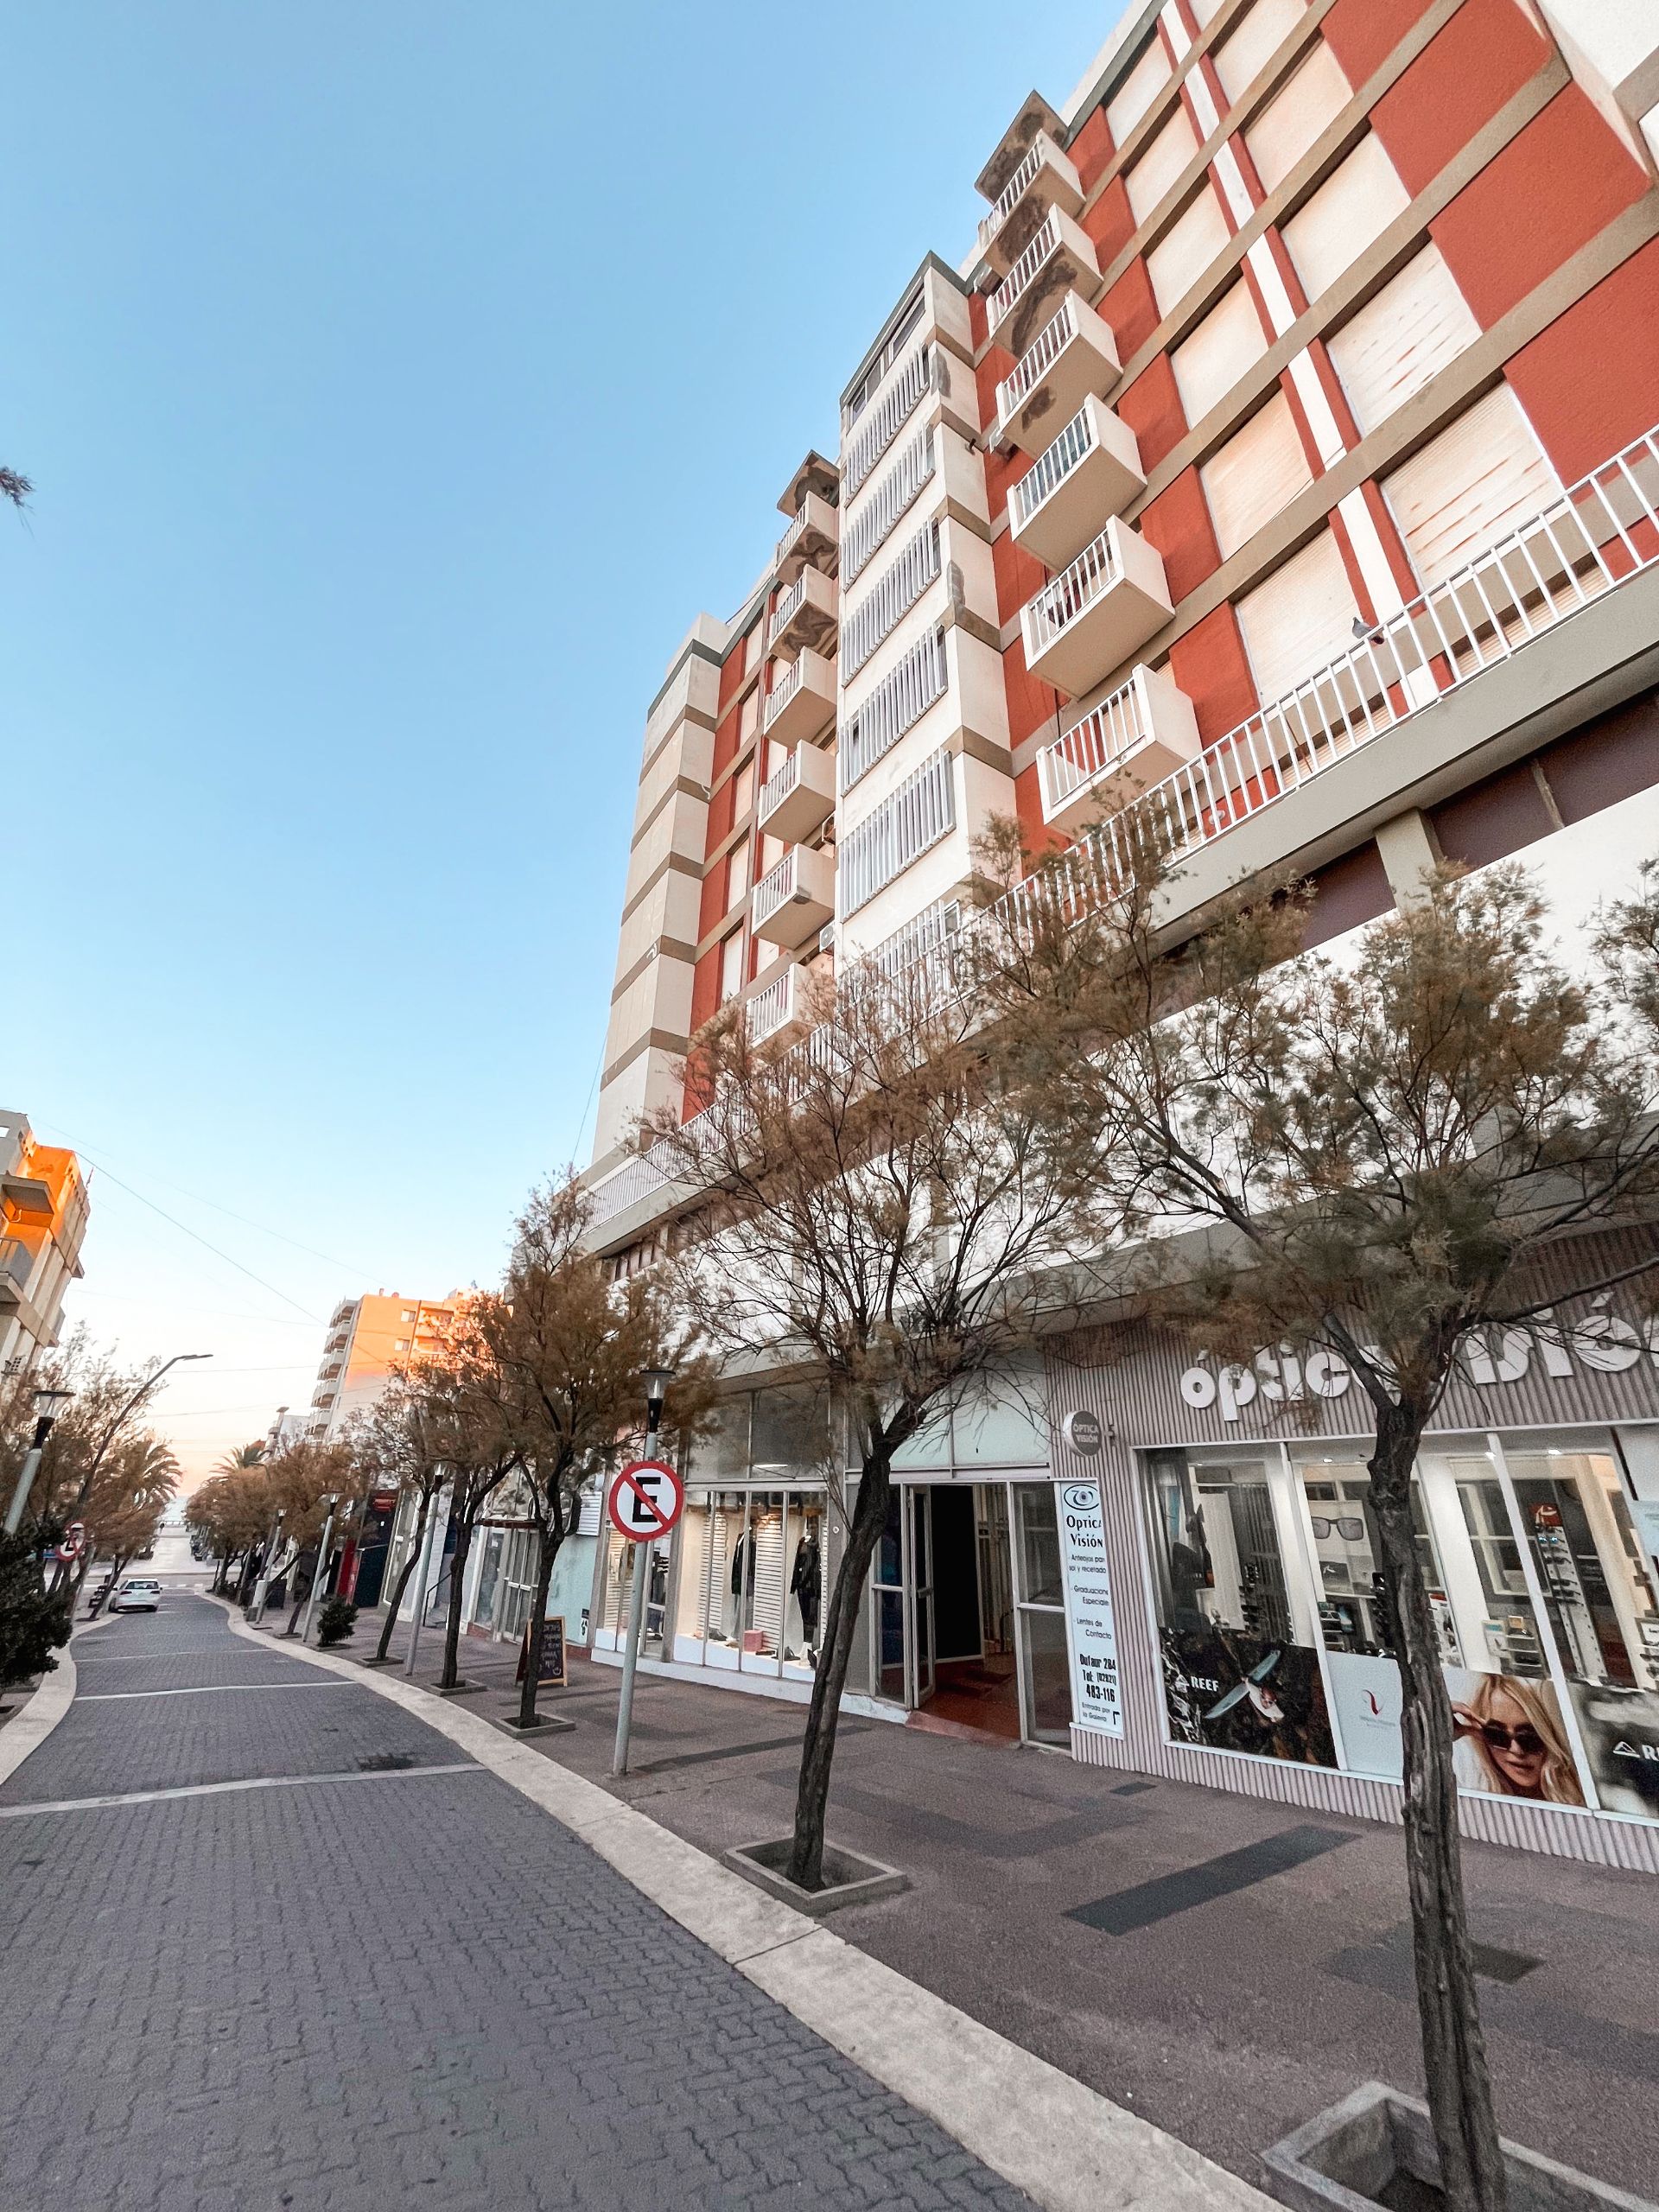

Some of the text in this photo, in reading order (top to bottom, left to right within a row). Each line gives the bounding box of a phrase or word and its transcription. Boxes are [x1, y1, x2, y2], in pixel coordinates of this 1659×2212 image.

[632, 1477, 661, 1522] E
[1070, 1533, 1103, 1548] Visión
[1077, 1618, 1094, 1626] Lentes
[1085, 1629, 1112, 1639] Contacto
[1103, 1657, 1116, 1670] 284
[1190, 1676, 1219, 1693] REEF
[1086, 1683, 1116, 1702] 483-116
